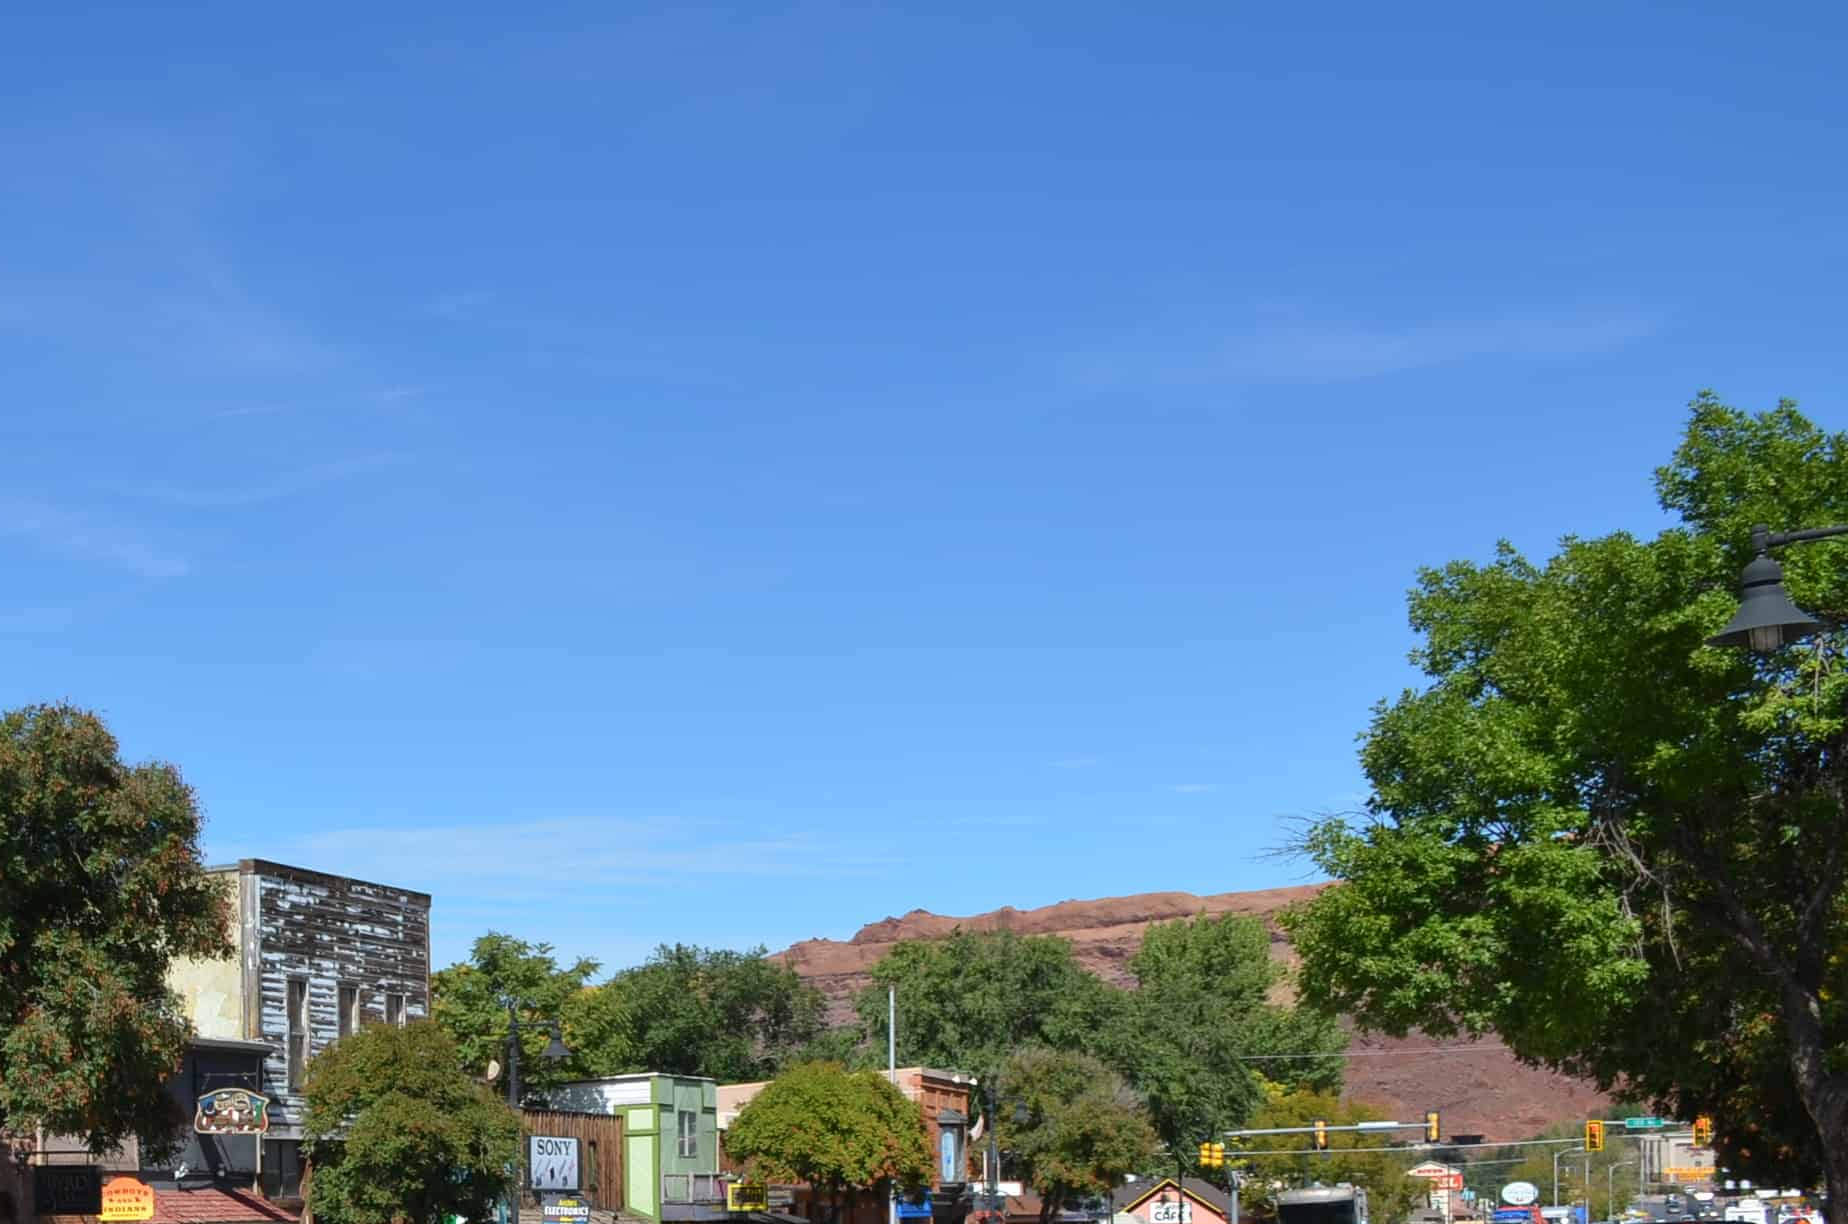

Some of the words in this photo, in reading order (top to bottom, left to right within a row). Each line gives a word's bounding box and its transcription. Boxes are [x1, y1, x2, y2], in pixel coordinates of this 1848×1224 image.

[536, 1138, 572, 1157] SONY
[544, 1206, 589, 1216] ELECTRONICS
[1154, 1211, 1183, 1221] CAF
